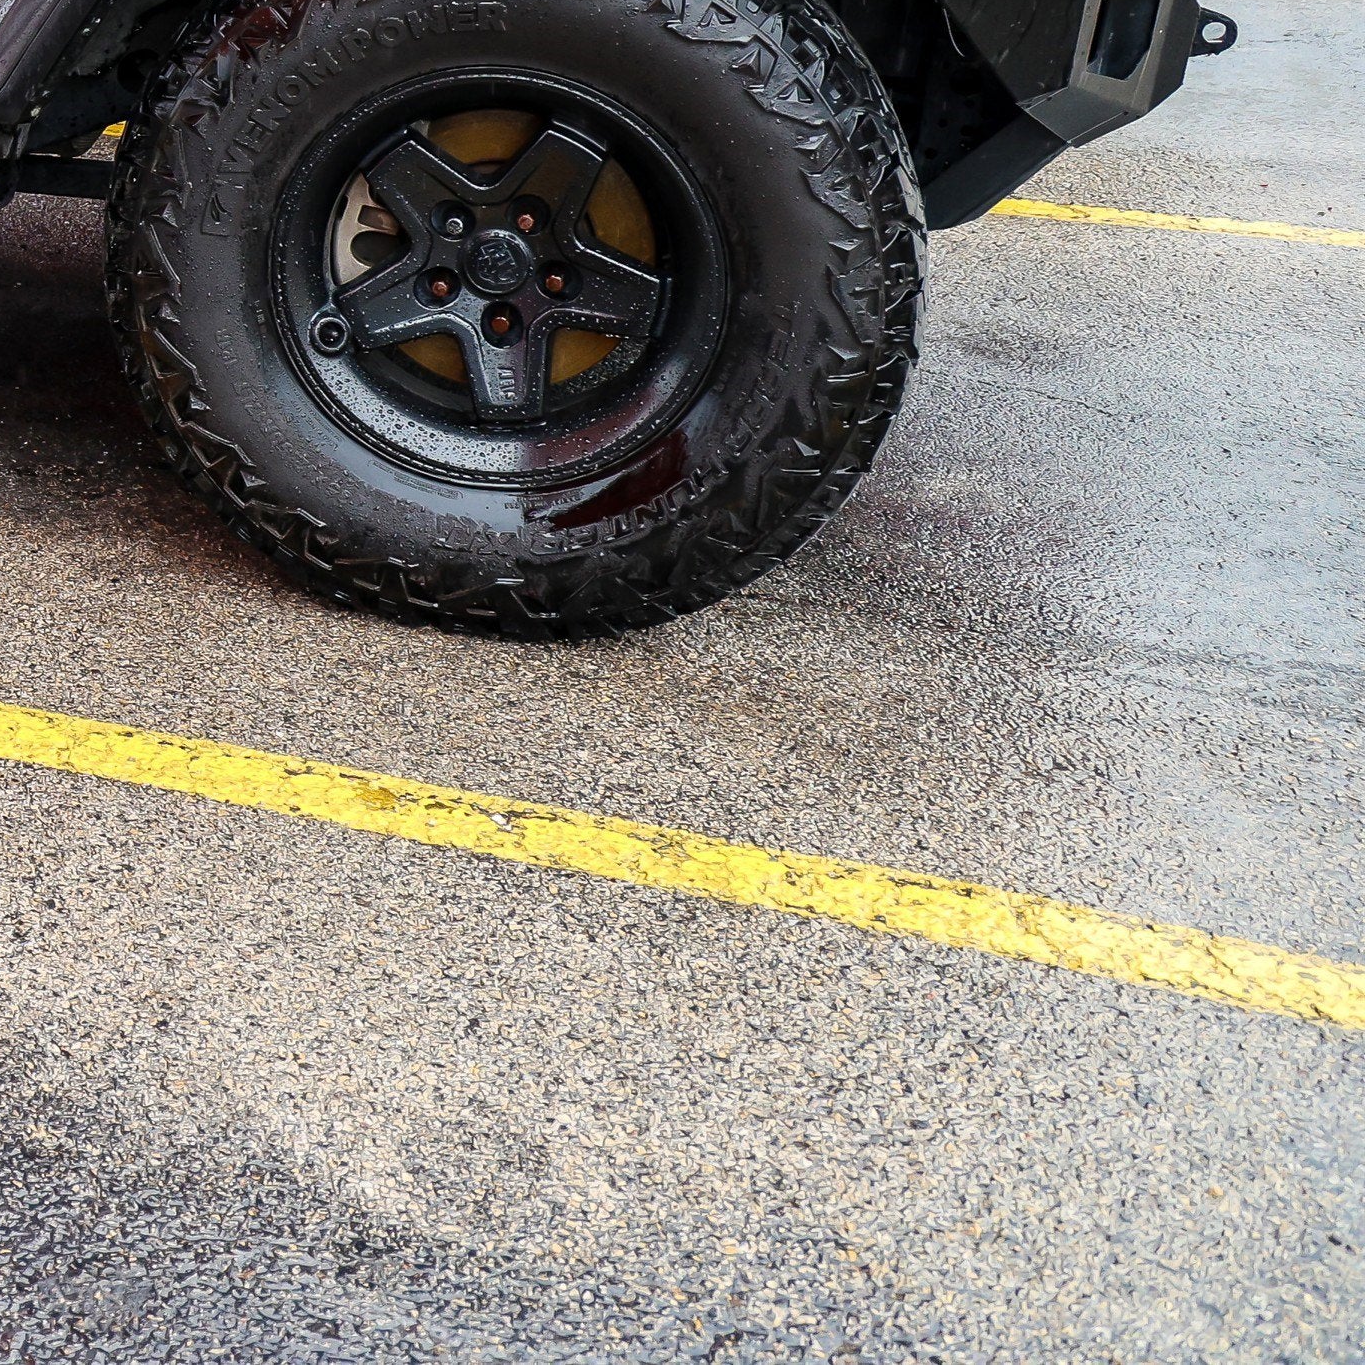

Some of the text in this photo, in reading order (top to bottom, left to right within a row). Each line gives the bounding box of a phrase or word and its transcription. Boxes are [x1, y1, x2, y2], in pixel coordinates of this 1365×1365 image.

[217, 1, 507, 173] VENOM POWER
[525, 460, 731, 556] HUNTER
